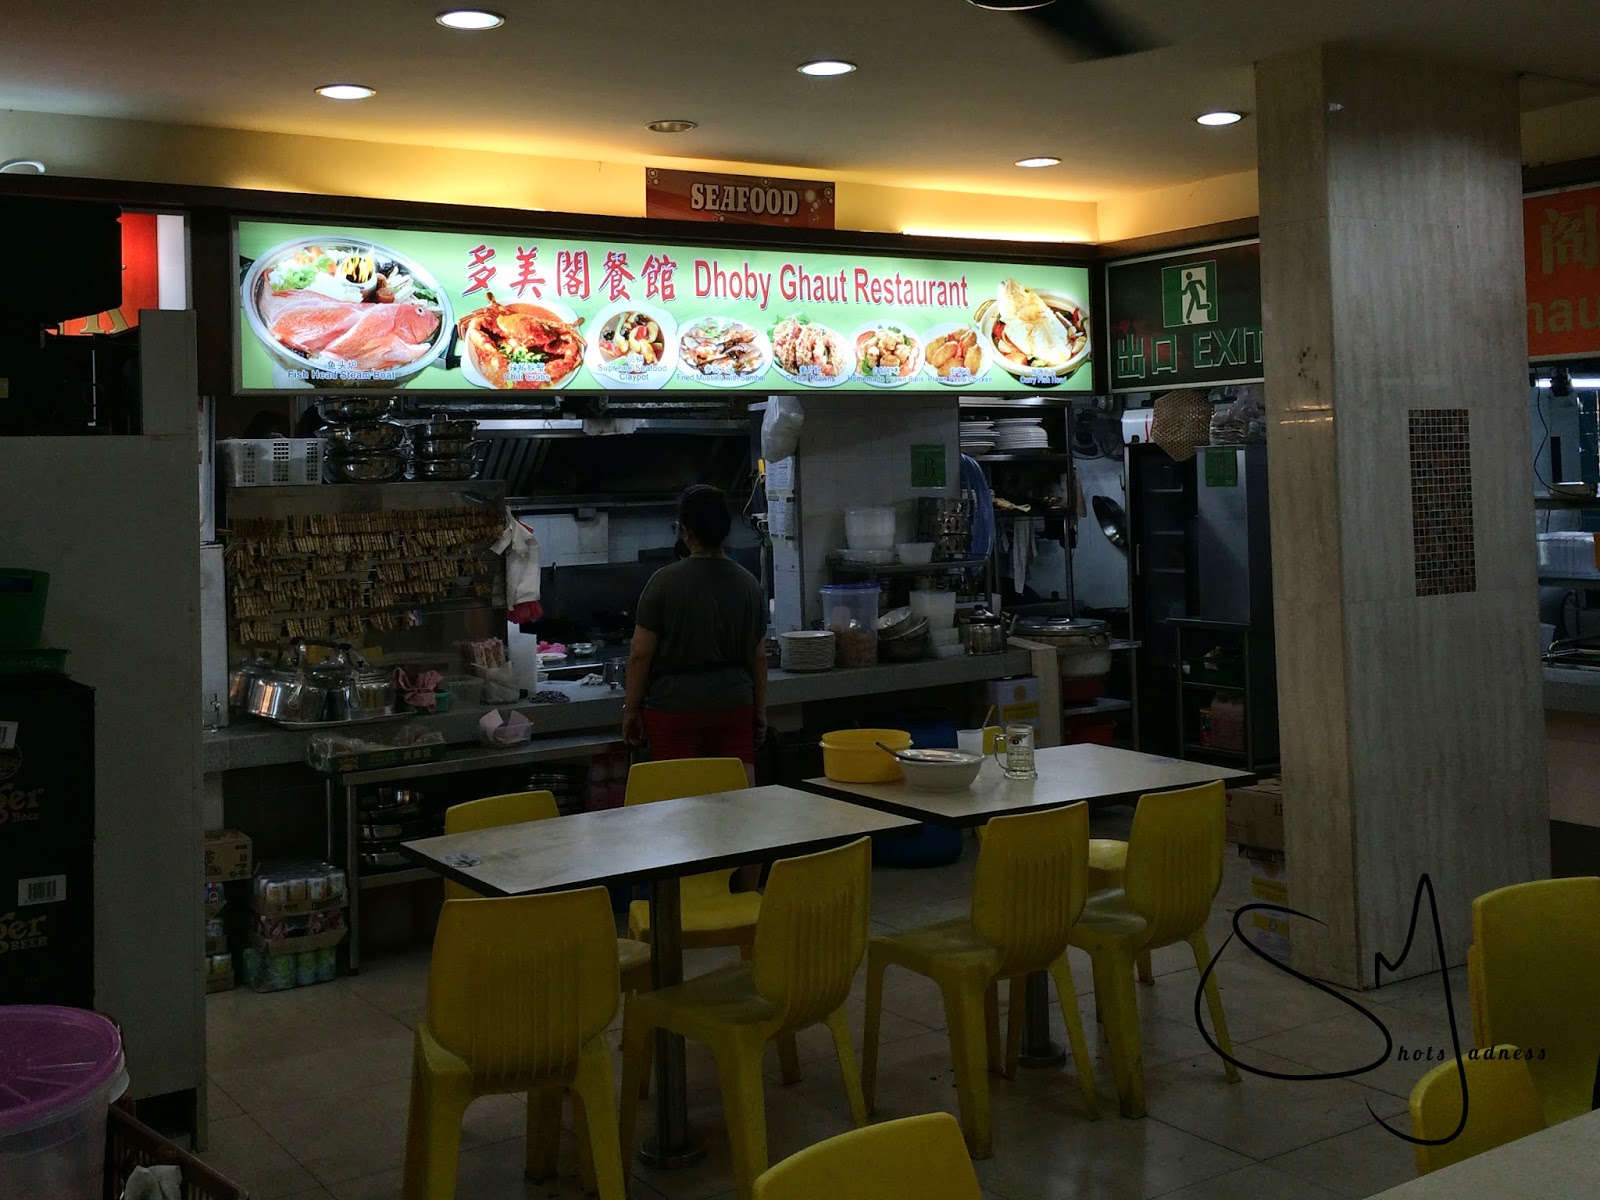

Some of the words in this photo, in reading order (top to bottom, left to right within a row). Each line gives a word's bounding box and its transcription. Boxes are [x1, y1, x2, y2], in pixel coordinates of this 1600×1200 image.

[690, 183, 799, 216] SEAFOOD
[462, 244, 677, 302] 多美閣餐館
[694, 259, 772, 310] Dhoby
[779, 263, 848, 303] Ghaut
[853, 267, 969, 308] Restaurant
[1117, 333, 1178, 379] 出口
[1193, 327, 1264, 369] EXIT
[287, 370, 309, 379] Fish
[312, 370, 337, 379] Head
[340, 371, 371, 380] Steam
[373, 371, 396, 380] Boat
[525, 373, 551, 381] Crabs
[619, 373, 650, 383] Claypot
[635, 363, 667, 372] Seafood
